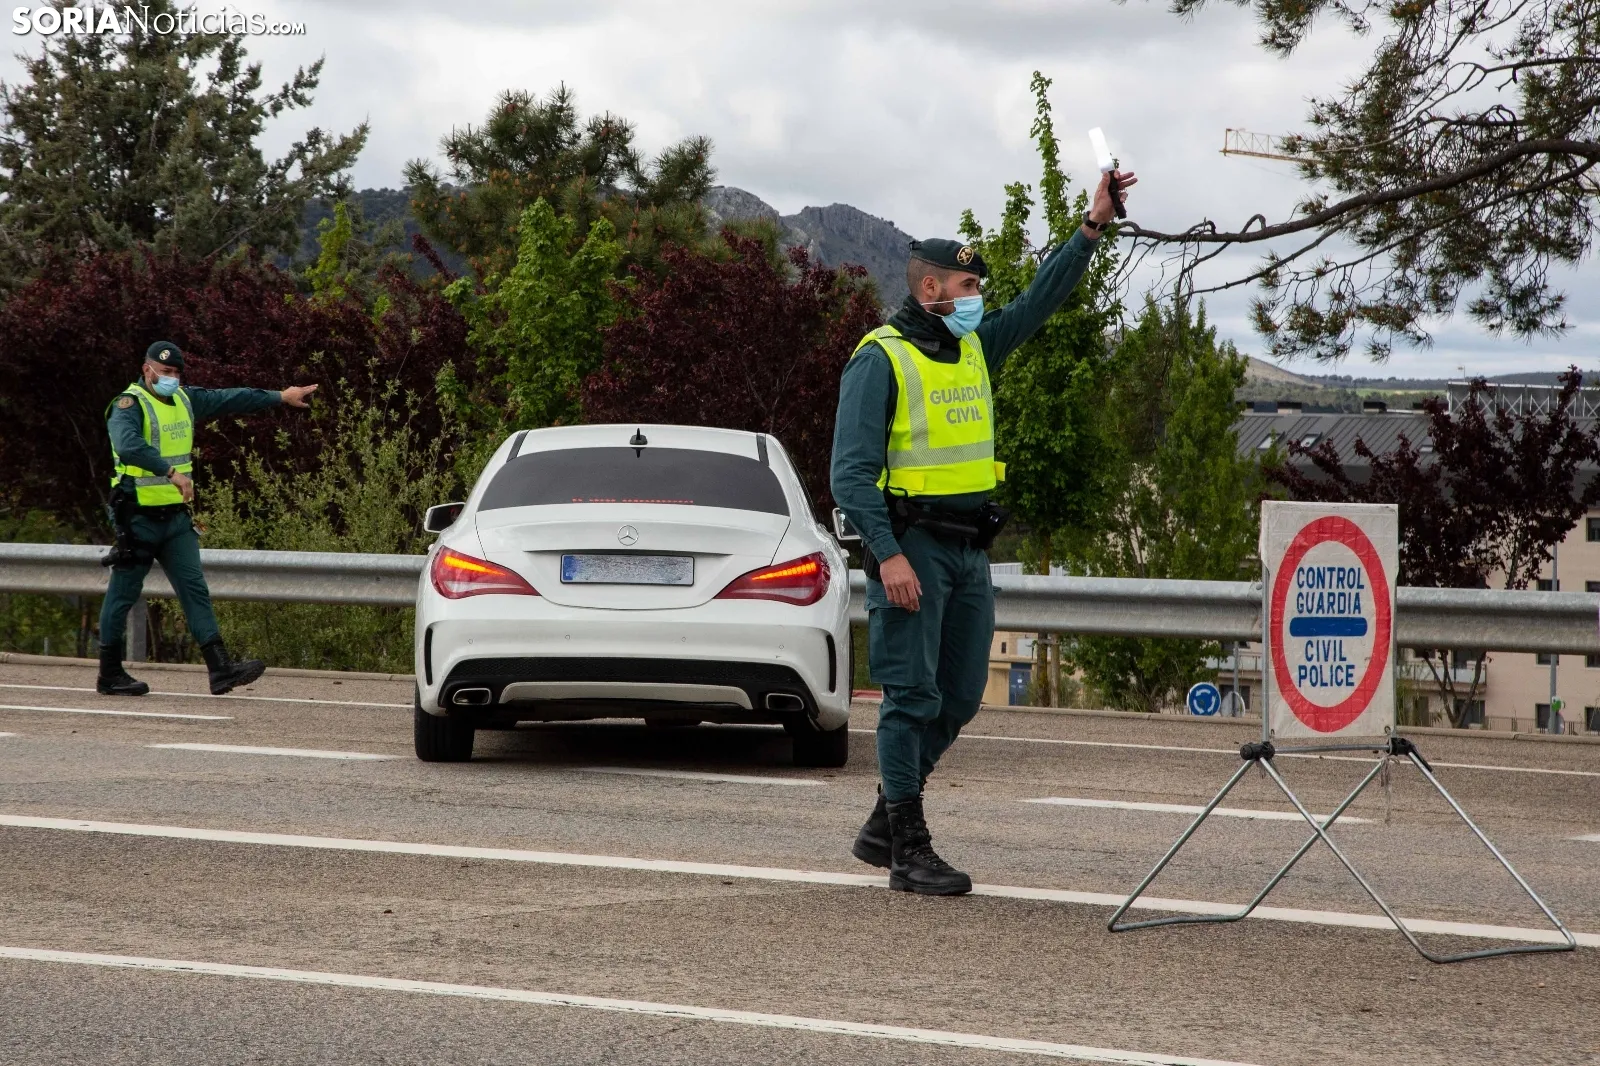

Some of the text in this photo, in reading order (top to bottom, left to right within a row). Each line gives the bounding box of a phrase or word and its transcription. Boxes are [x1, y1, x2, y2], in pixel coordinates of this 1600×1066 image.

[162, 420, 190, 432] GUARDIA
[946, 405, 983, 425] CIVIL
[170, 430, 187, 440] CIVIL
[1296, 566, 1365, 589] CONTROL
[1296, 592, 1362, 615] GUARDIA
[1305, 640, 1347, 662] CIVIL
[1298, 664, 1355, 688] POLICE
